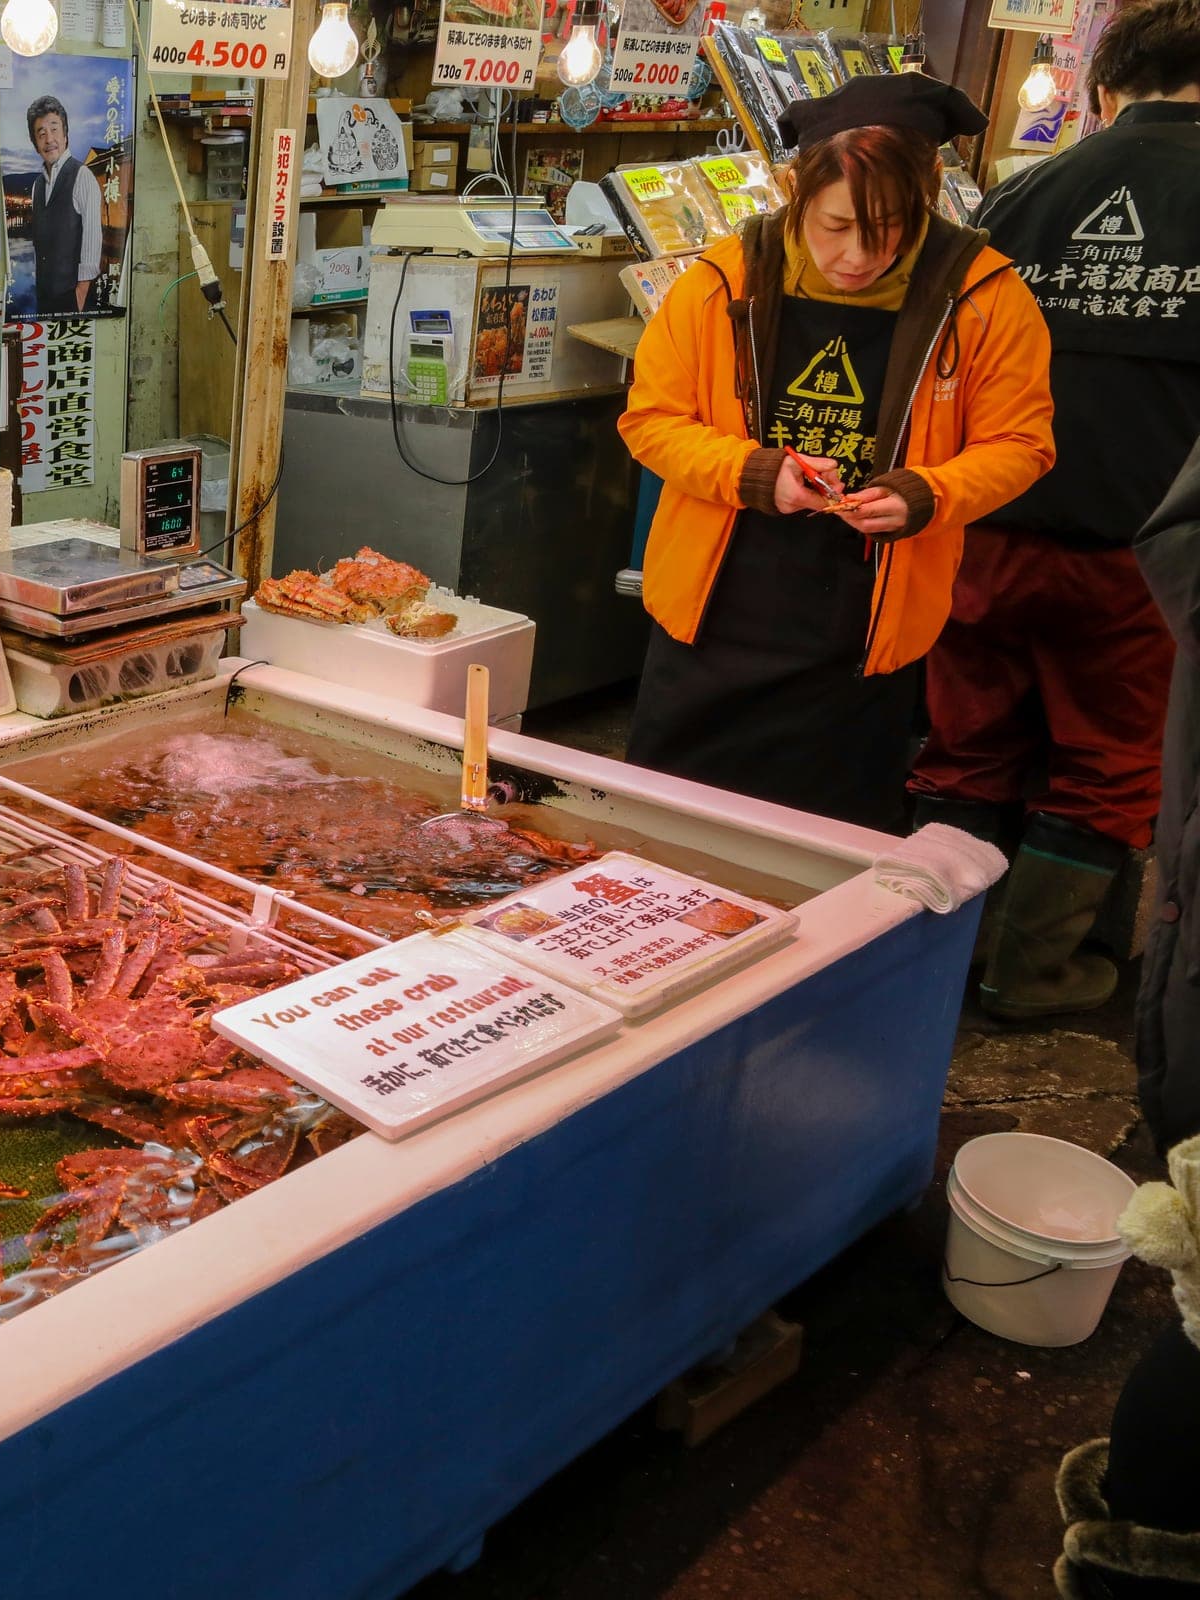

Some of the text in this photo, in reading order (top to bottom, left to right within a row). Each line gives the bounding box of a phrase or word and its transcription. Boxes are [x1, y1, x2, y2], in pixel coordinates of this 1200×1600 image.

[447, 30, 532, 51] 解凍してそのまま食べるだけ
[153, 46, 186, 64] 400g
[273, 53, 285, 69] 円
[438, 64, 461, 79] 730g
[523, 69, 533, 84] 円
[613, 68, 633, 82] 500g
[681, 71, 689, 85] 円
[270, 135, 291, 254] 防犯カメラ設置
[1109, 185, 1131, 204] 小
[1099, 215, 1124, 234] 樽
[1061, 244, 1143, 263] 三角市場
[532, 287, 556, 301] あわび
[1082, 294, 1186, 318] 滝波食堂
[825, 336, 847, 358] 小
[814, 370, 840, 393] 樽
[774, 400, 862, 429] 三角市場
[161, 517, 182, 531] 1600
[535, 891, 670, 952] ご注文を頂いてから
[564, 888, 711, 960] 茹で上げて発送します
[593, 936, 675, 976] 又、活きたままの
[612, 932, 716, 985] 状態でも発送出来ます
[251, 966, 400, 1030] You can eat
[334, 972, 459, 1032] these crab
[365, 974, 535, 1057] at our restaurant.
